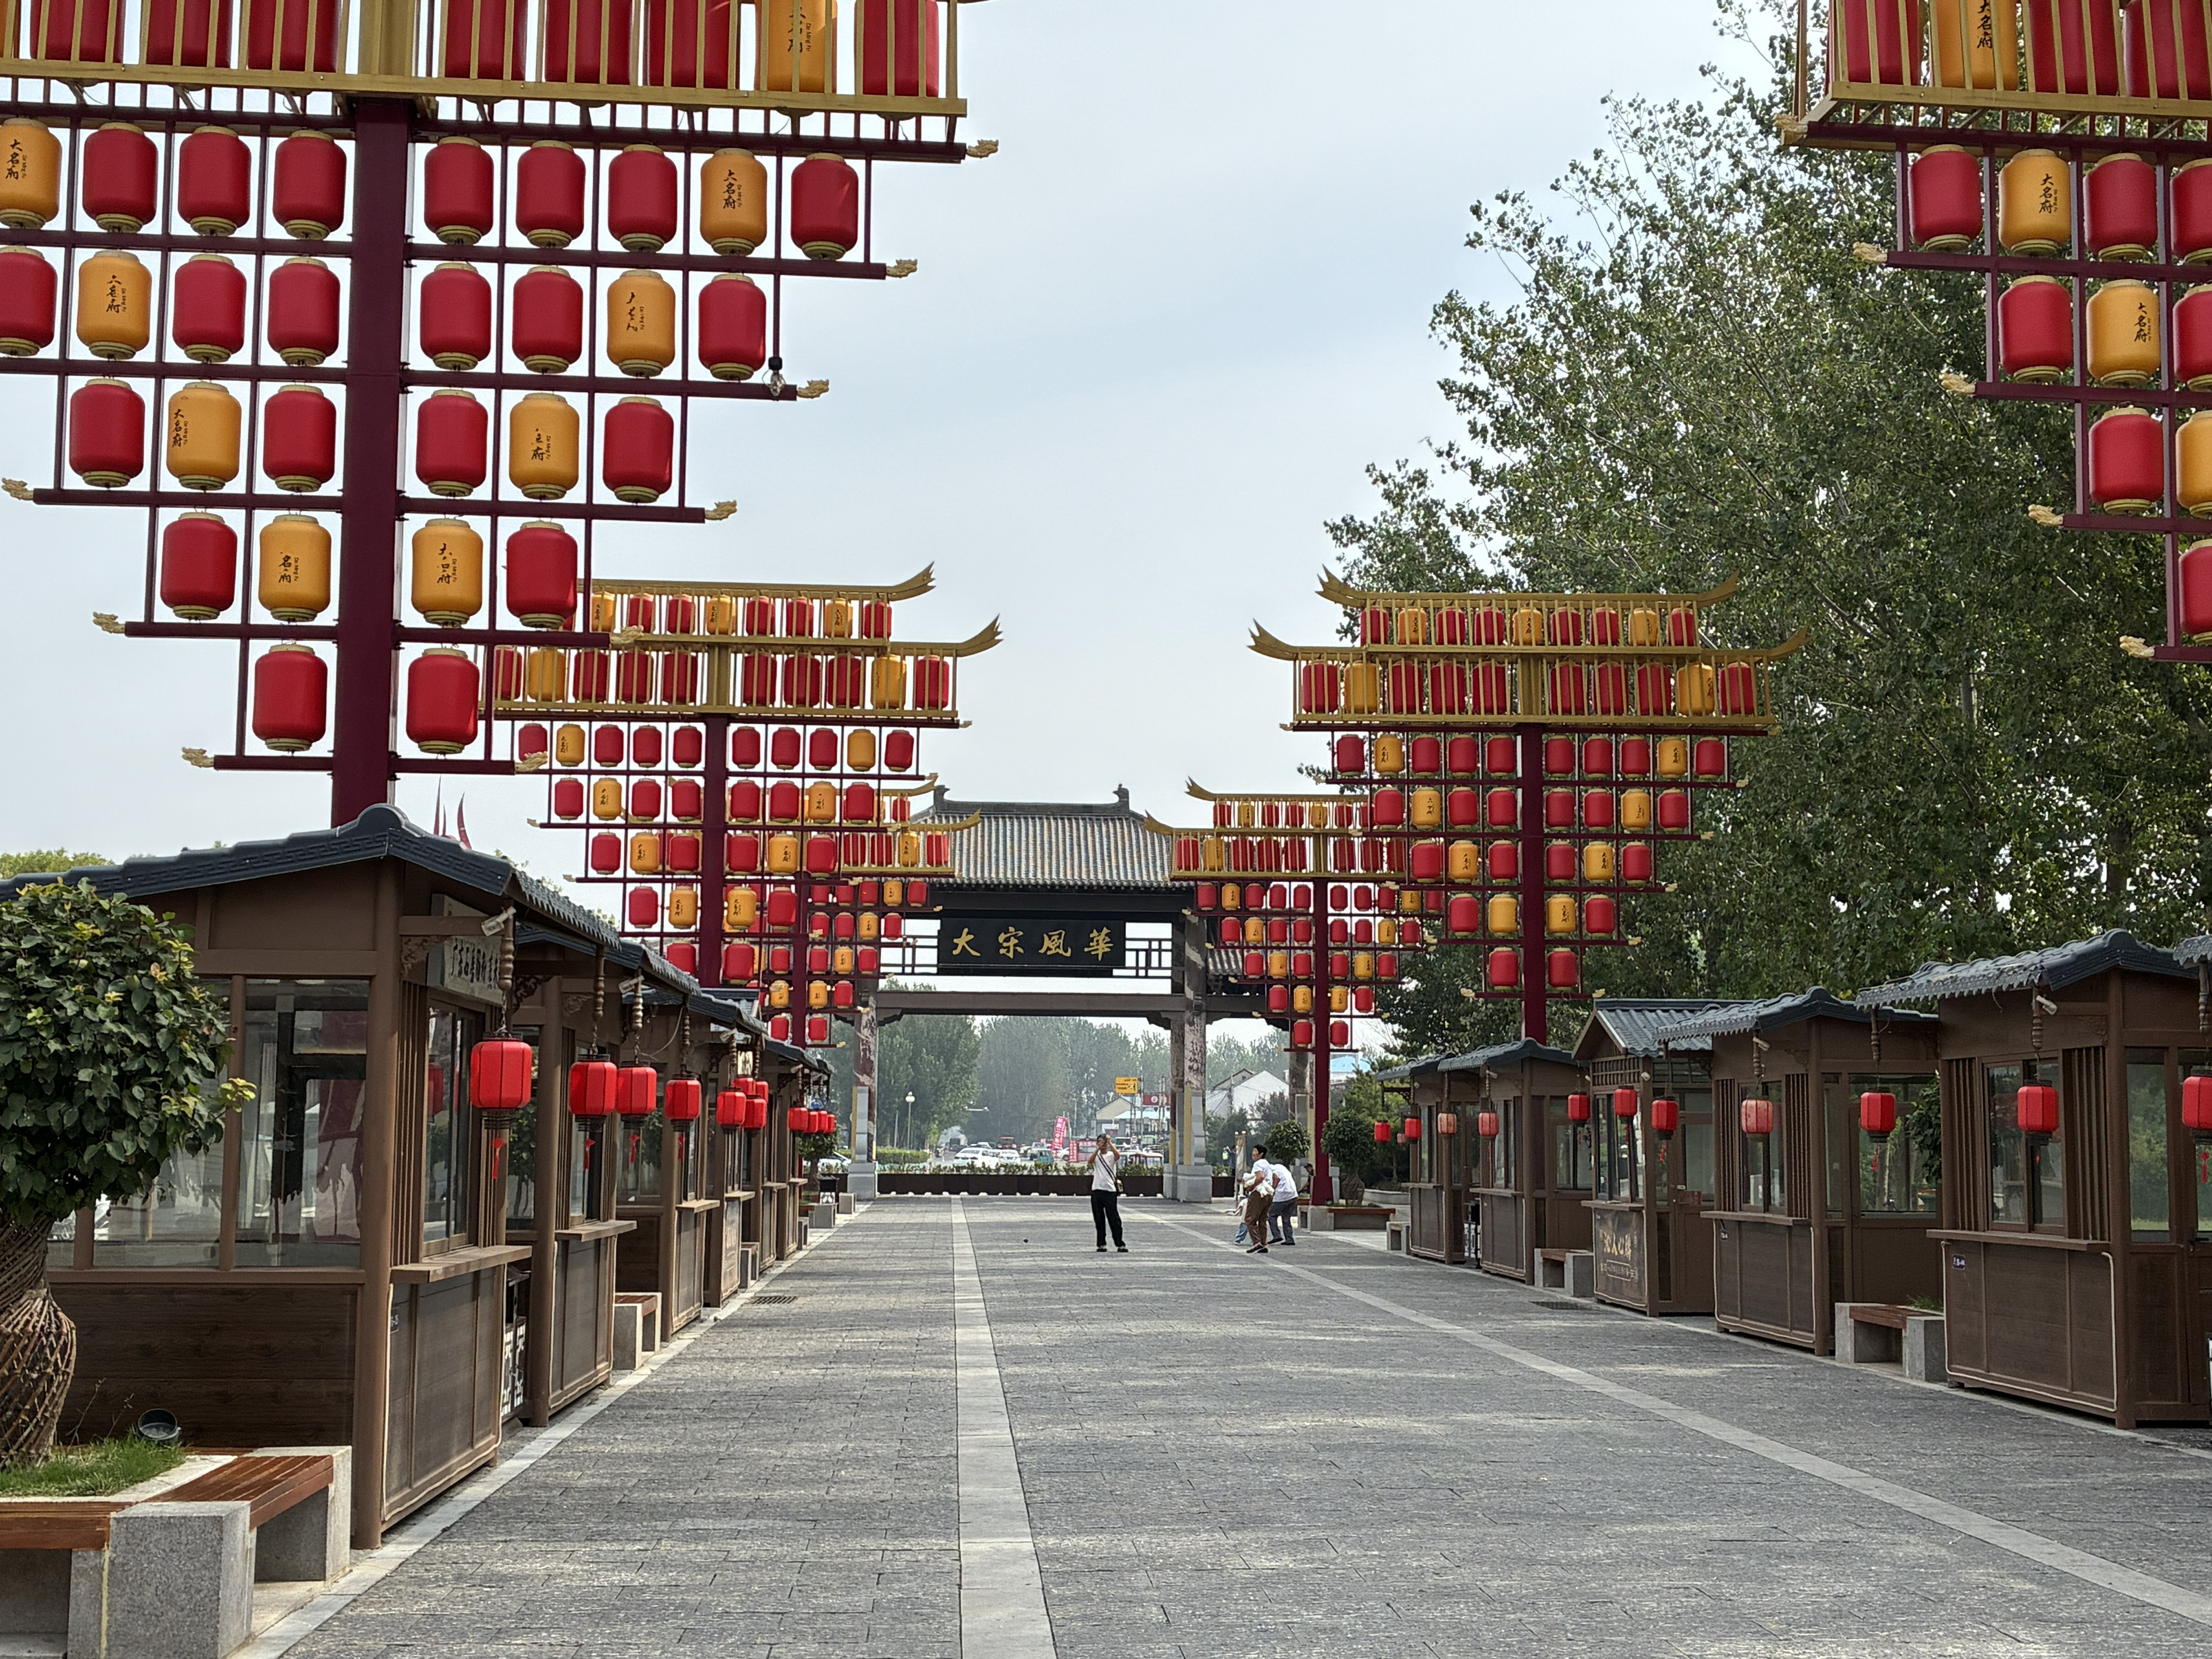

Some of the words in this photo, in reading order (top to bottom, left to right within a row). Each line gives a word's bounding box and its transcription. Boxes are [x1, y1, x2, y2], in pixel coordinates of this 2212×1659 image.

[6, 139, 22, 180] 大名府
[723, 169, 737, 210] 大名府
[2039, 173, 2054, 214] 大名府
[2134, 302, 2148, 343] 大名府
[172, 409, 184, 448] 大名府
[952, 926, 1114, 962] 大宋風華
